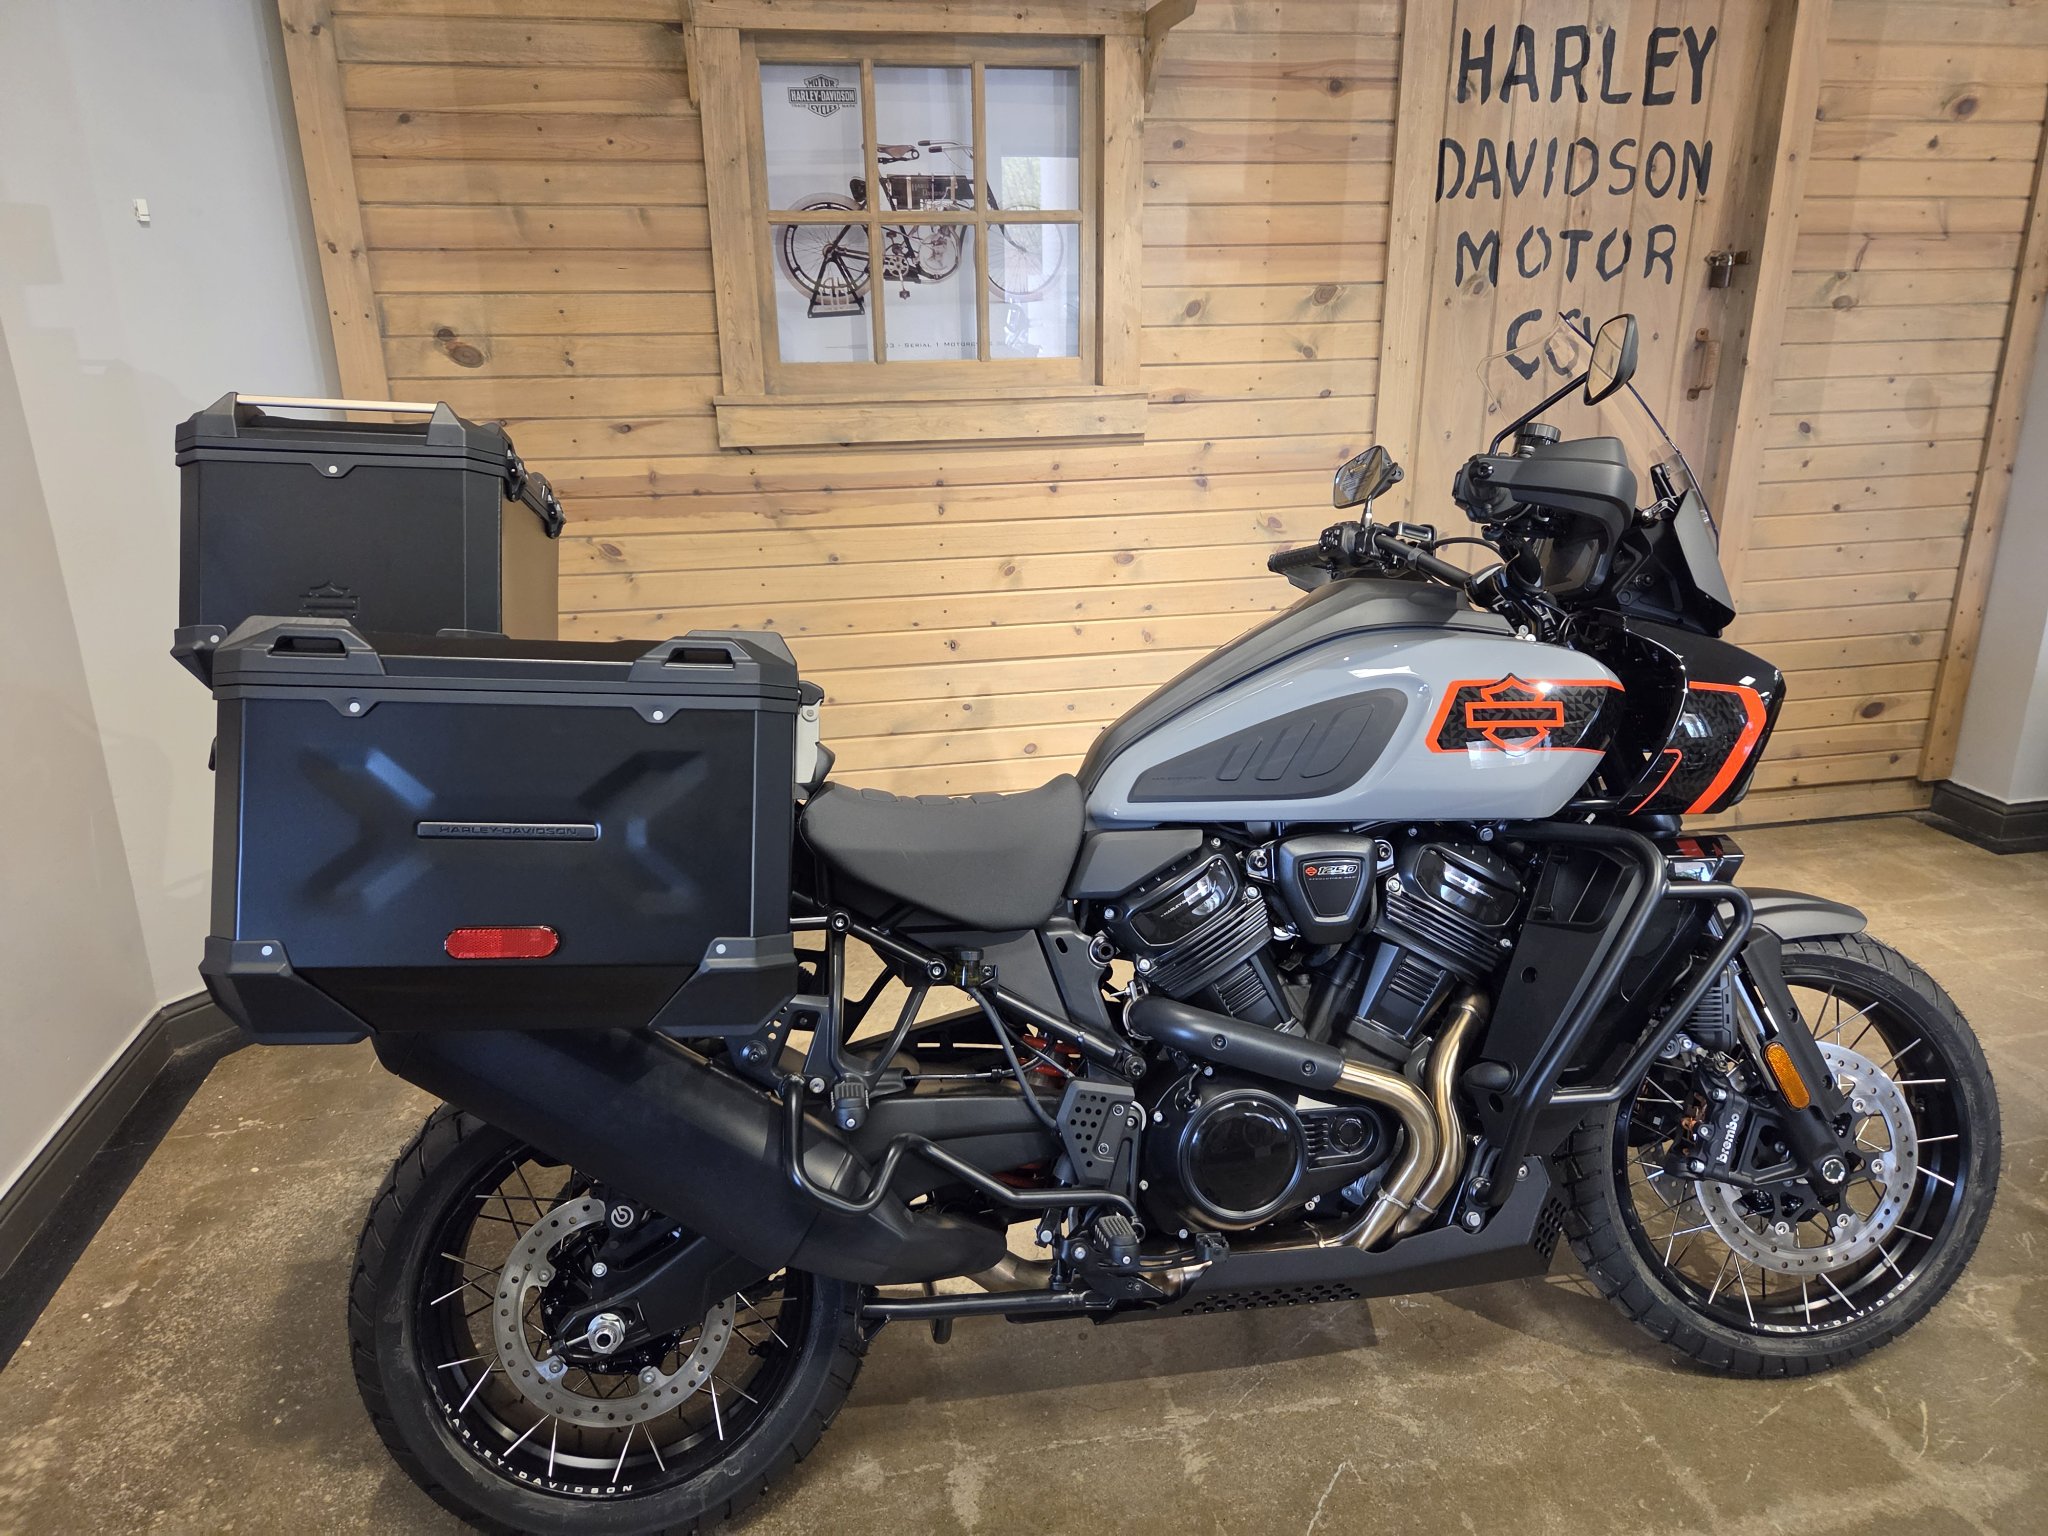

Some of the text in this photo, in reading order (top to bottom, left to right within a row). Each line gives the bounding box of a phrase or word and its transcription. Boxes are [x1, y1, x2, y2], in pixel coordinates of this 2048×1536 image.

[808, 77, 835, 87] MOTOR
[1456, 24, 1717, 106] HARLEY
[811, 104, 837, 115] CYCLES
[1436, 136, 1713, 202] DAVIDSON
[1455, 223, 1676, 288] MOTOR
[439, 824, 578, 836] HARLEY-DAVIDSON
[1317, 864, 1358, 876] 1250
[1716, 1113, 1740, 1164] brembo
[1750, 1274, 1915, 1333] HARLEY-DAVIDSON
[444, 1403, 632, 1494] HARLEY-DAVIDSON
